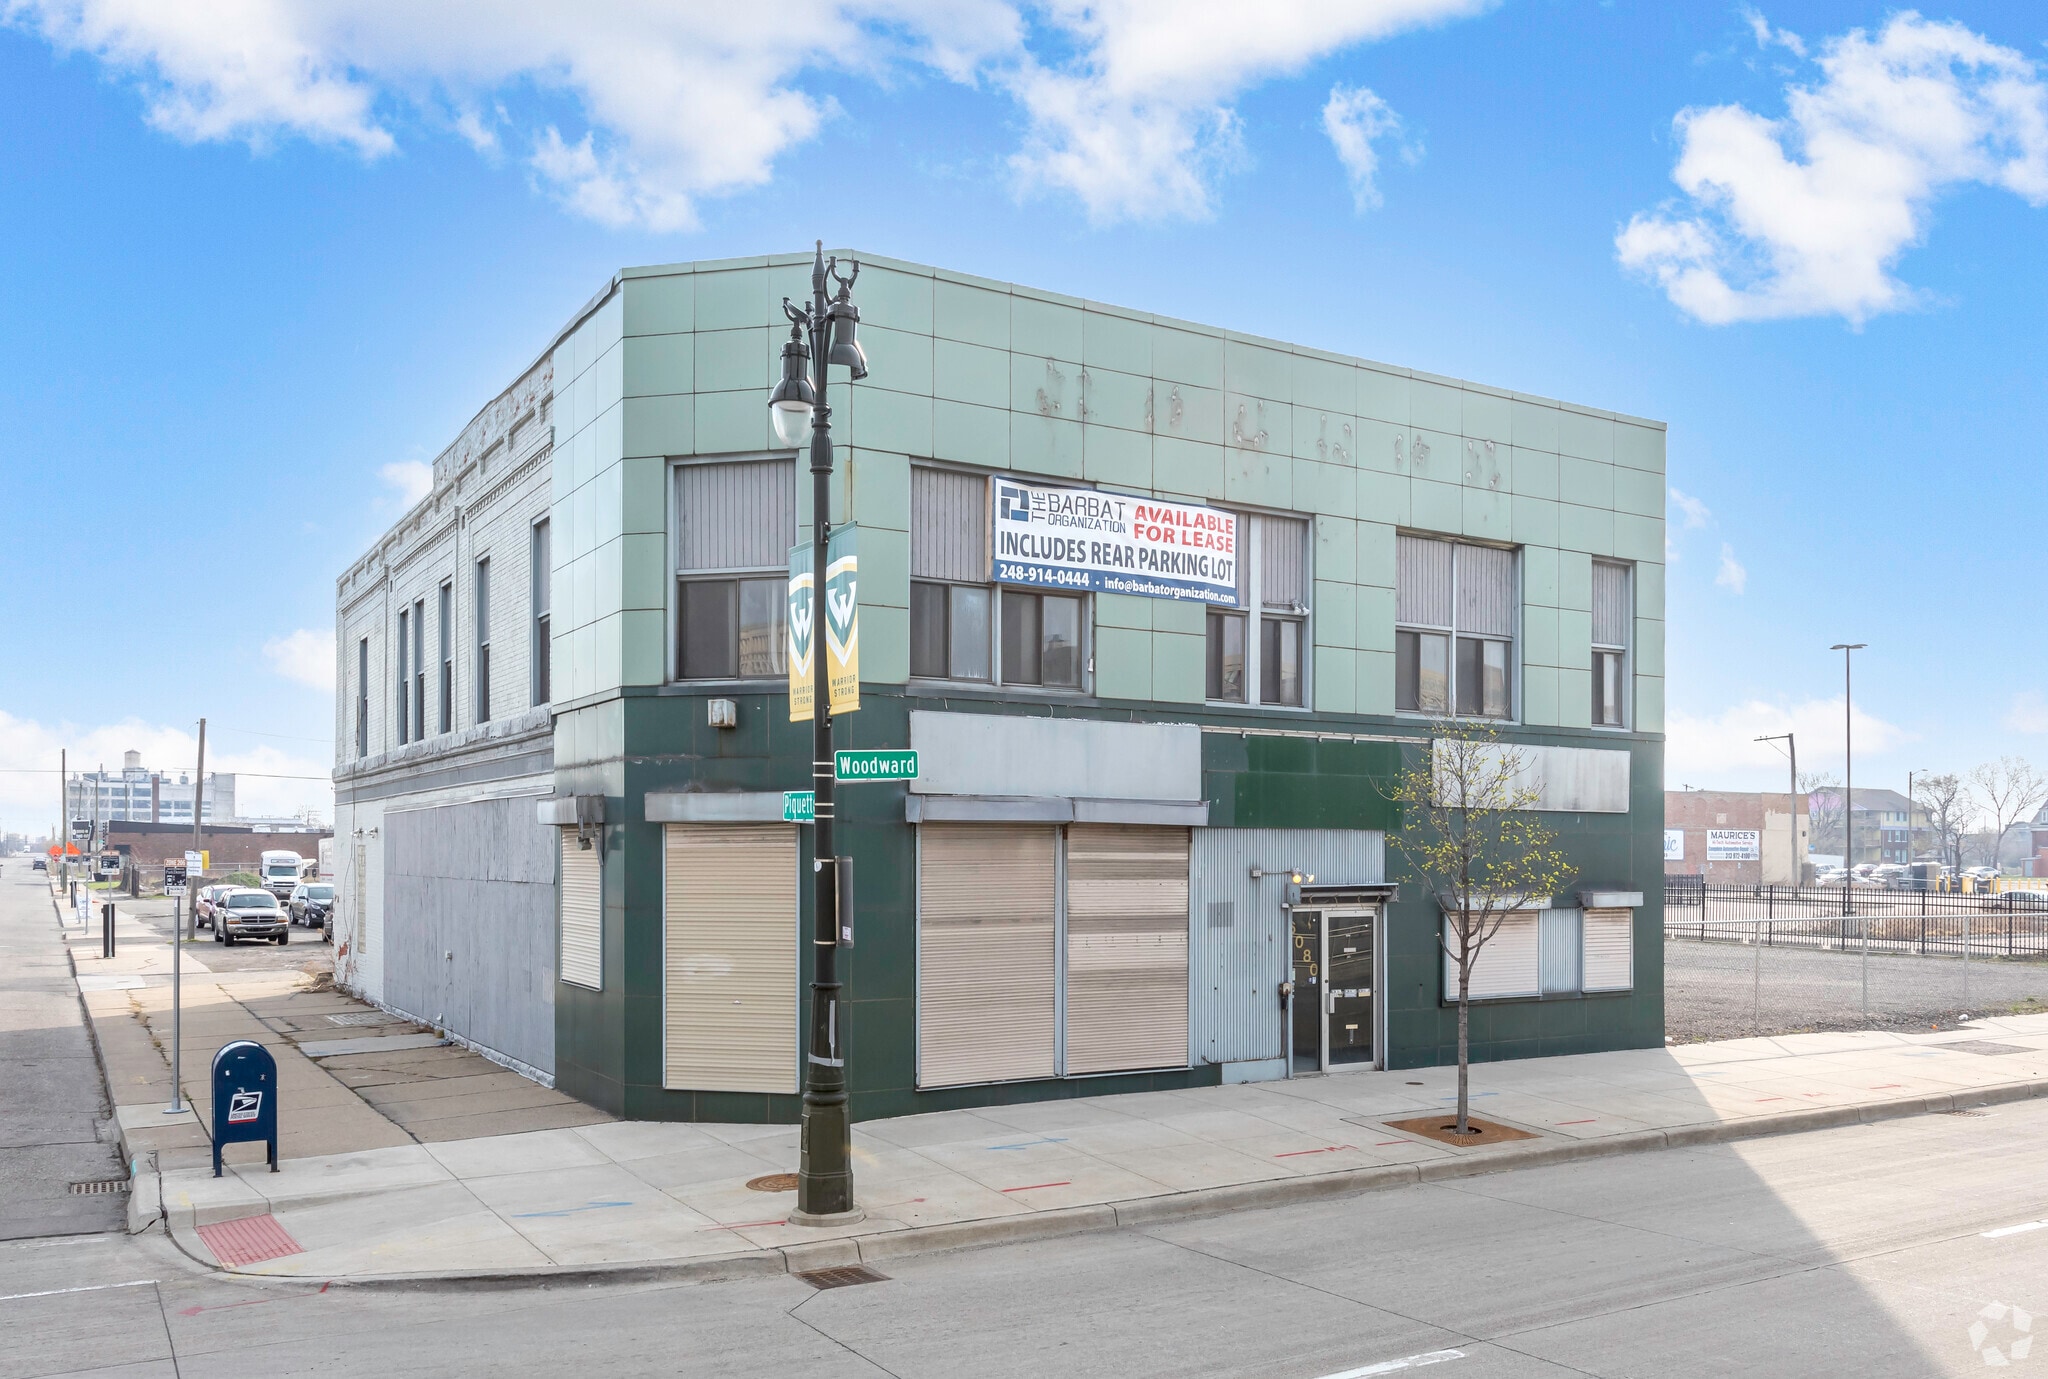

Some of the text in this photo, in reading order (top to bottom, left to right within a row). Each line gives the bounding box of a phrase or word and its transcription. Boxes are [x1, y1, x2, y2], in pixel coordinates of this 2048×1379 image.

[1031, 491, 1046, 523] THE
[1048, 493, 1126, 521] BARBAT
[1134, 505, 1234, 535] AVAILABLE
[1048, 513, 1127, 534] ORGANIZATION
[1134, 523, 1234, 554] FOR LEASE
[1000, 530, 1233, 581] INCLUDES REAR PARKING LOT
[999, 563, 1236, 604] 248-914-0444 info@barbatorganization.com
[831, 674, 856, 687] WARRIOR
[834, 685, 855, 698] STRONG
[840, 756, 915, 775] Woodward
[1710, 831, 1756, 840] MAURICE'S
